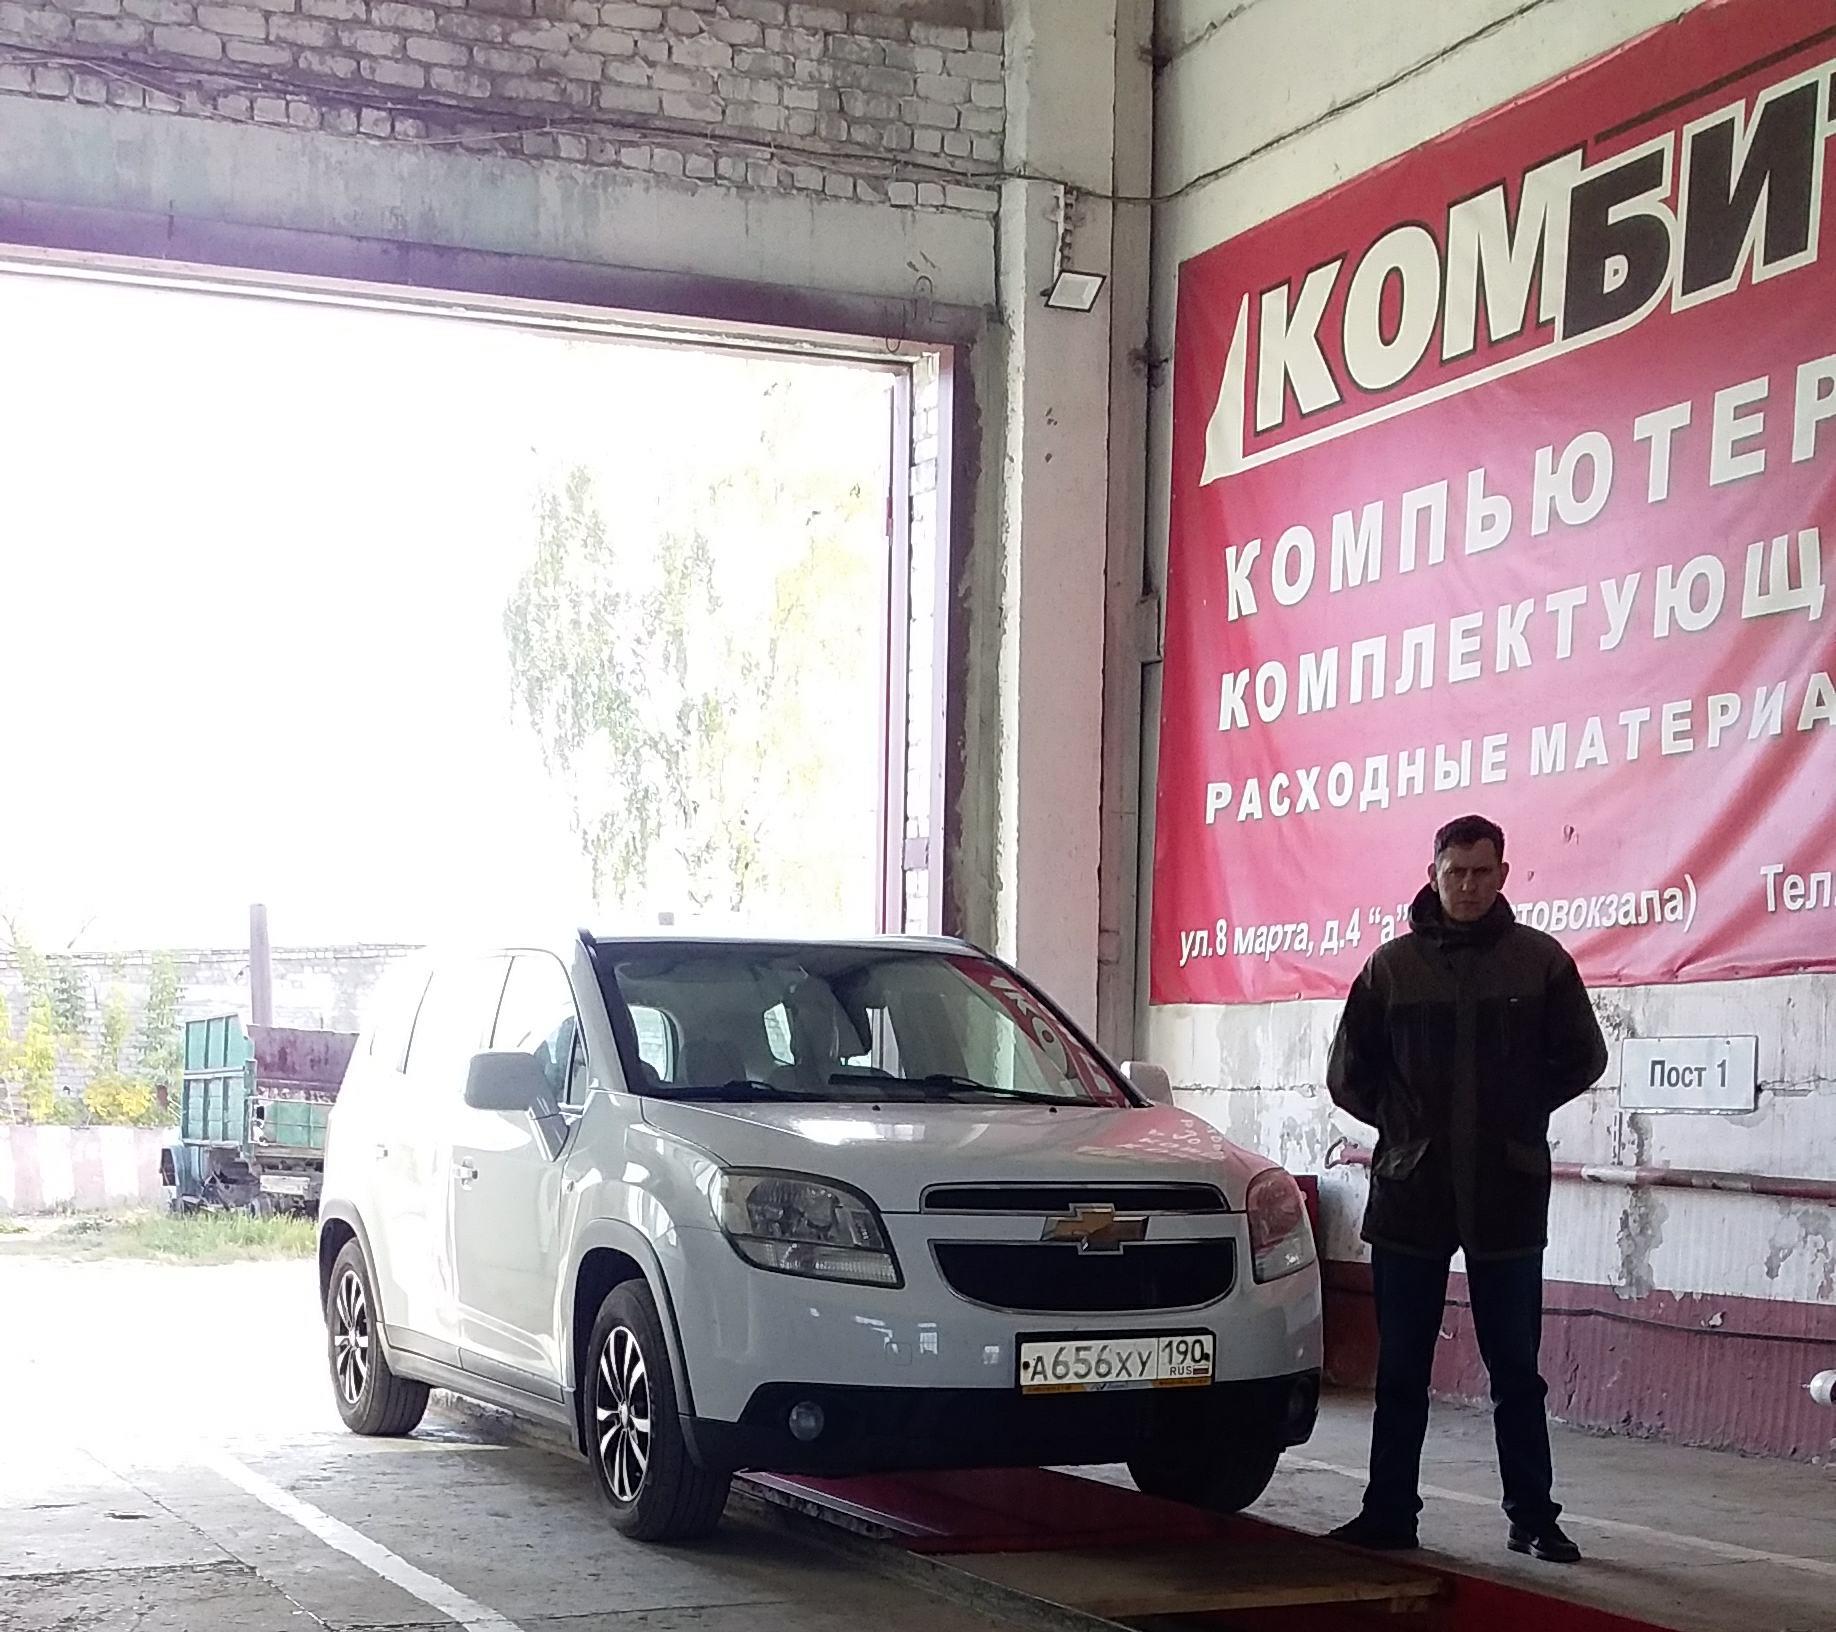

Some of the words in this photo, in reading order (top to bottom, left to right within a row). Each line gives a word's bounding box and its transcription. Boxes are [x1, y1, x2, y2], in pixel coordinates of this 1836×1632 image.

[1254, 58, 1836, 436] КОМБИ
[1225, 353, 1836, 622] КОМПЬЮТЕР
[1218, 527, 1825, 732] КОМПЛЕКТУЮЩ
[1205, 733, 1508, 825] РАСХОДНЫЕ
[1530, 671, 1836, 776] МАТЕРИА
[1233, 920, 1314, 961] марта,
[1320, 907, 1361, 956] д.4
[1510, 873, 1698, 934] товокзала)
[1760, 863, 1836, 912] Тел
[1650, 1059, 1706, 1088] Пост
[1716, 1058, 1727, 1088] 1
[1161, 1338, 1206, 1366] 190
[1169, 1365, 1193, 1376] RUS
